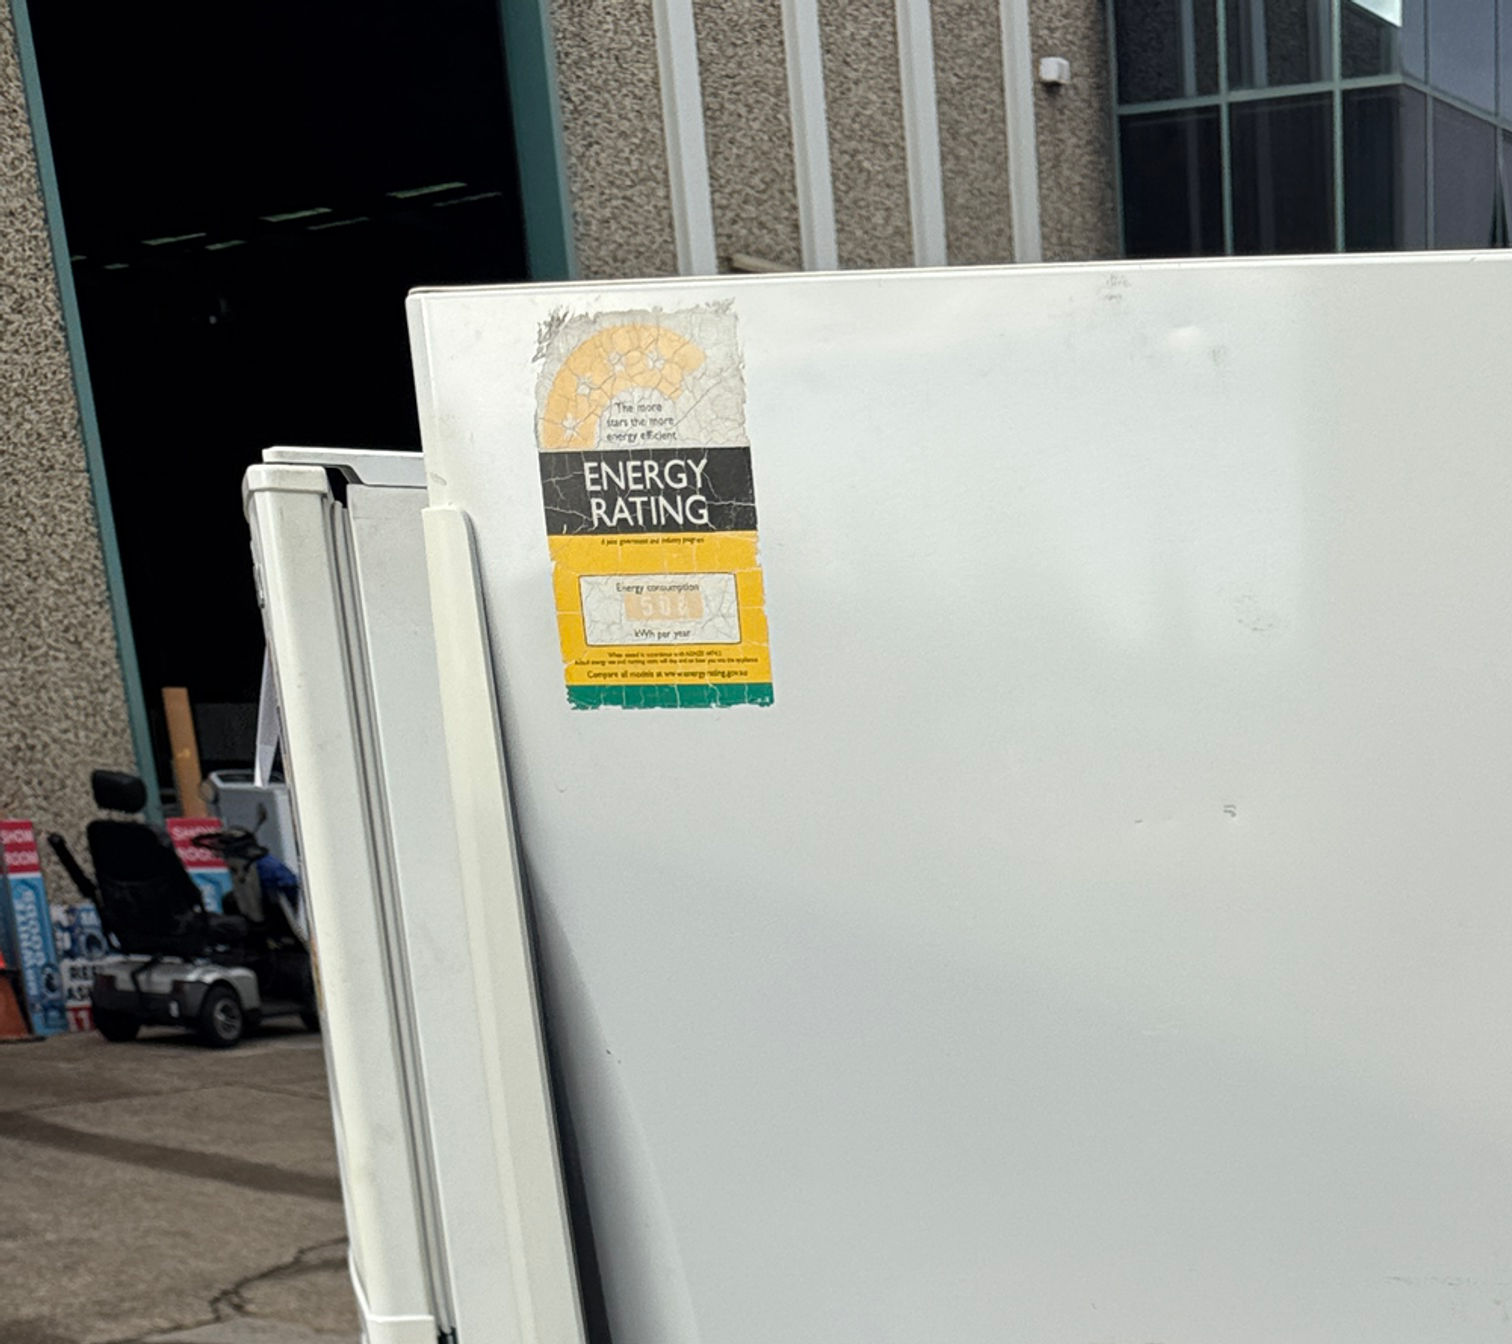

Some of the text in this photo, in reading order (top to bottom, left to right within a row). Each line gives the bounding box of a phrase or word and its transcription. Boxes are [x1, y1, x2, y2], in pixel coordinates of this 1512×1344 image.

[636, 403, 663, 412] more
[630, 416, 647, 427] the
[649, 416, 675, 426] more
[606, 432, 638, 443] energy
[584, 458, 708, 491] ENERGY
[590, 494, 709, 528] RATING
[615, 581, 700, 595] Energy consumption
[633, 628, 656, 638] kWh
[657, 630, 671, 640] per
